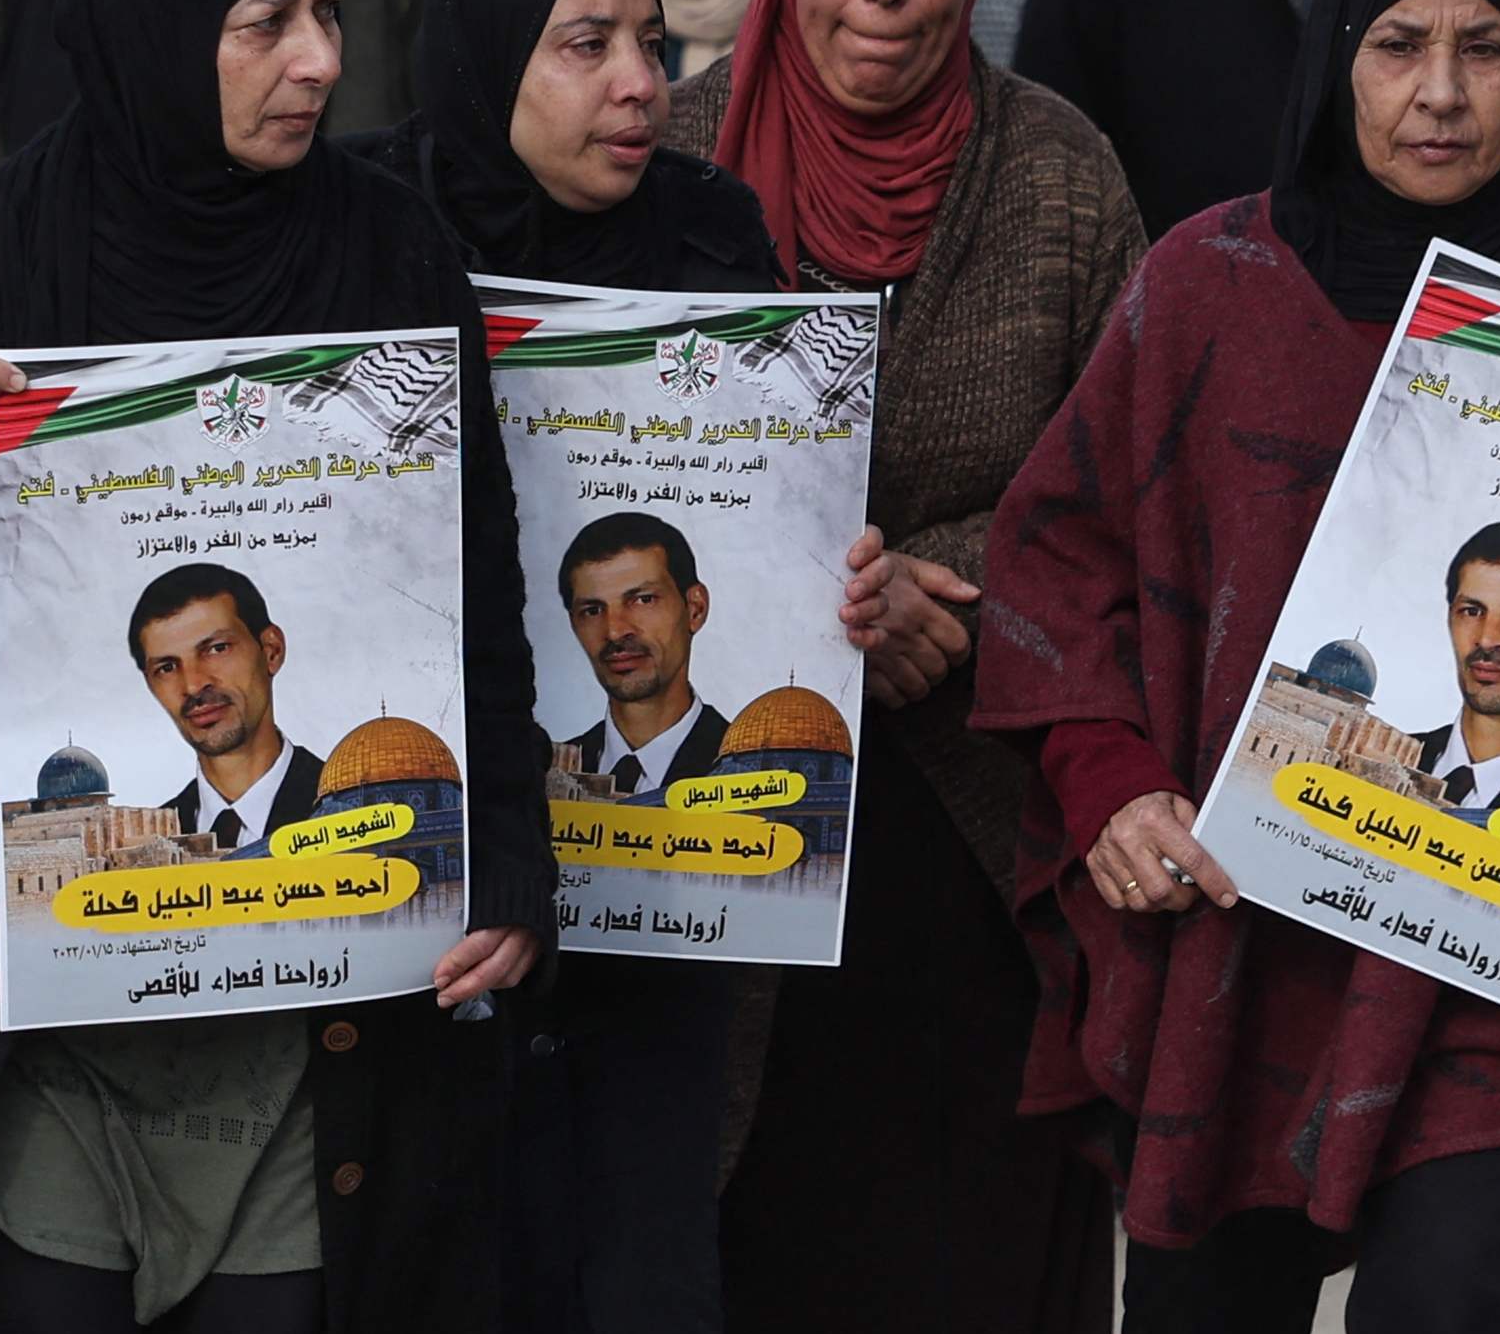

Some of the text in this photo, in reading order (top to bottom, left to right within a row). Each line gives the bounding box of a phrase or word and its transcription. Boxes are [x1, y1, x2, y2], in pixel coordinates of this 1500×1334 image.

[1406, 371, 1450, 400] فتح
[526, 409, 626, 437] الفلسطيني
[630, 416, 693, 443] الوطني
[698, 419, 762, 445] التحرير
[764, 416, 810, 445] حركة
[813, 422, 854, 445] تنعى
[566, 448, 767, 473] اقليم رام الله والبيرة موقع رمون
[14, 453, 435, 506] تنعى حركة التحرير الوطني الفلسطيني فتح
[577, 480, 750, 509] بمزيد من الفخر والاعتزاز
[119, 494, 332, 525] اقليم رام الله والبيرة موقع رمون
[136, 528, 317, 559] بمزيد من الفخر والاعتزاز
[682, 775, 788, 809] الشهيد البطل
[1297, 776, 1353, 820] كحلة
[287, 810, 396, 855] الشهيد البطل
[612, 830, 653, 858] عبد
[721, 824, 776, 860] أحمد
[1354, 808, 1421, 851] الجليل
[662, 833, 713, 858] حسن
[1310, 842, 1365, 869] الاستشهاد:
[1424, 837, 1465, 870] عبد
[558, 869, 591, 889] تاريخ
[1361, 860, 1396, 884] تاريخ
[82, 860, 389, 920] أحمد حسن عبد الجليل كحلة
[1301, 884, 1376, 921] للأقصى
[589, 903, 642, 933] فداء
[651, 905, 726, 943] أرواحنا
[1379, 911, 1435, 946] فداء
[116, 937, 173, 958] الاستشهاد:
[174, 934, 207, 956] تاريخ
[127, 948, 349, 1004] أرواحنا فداء للأقصى
